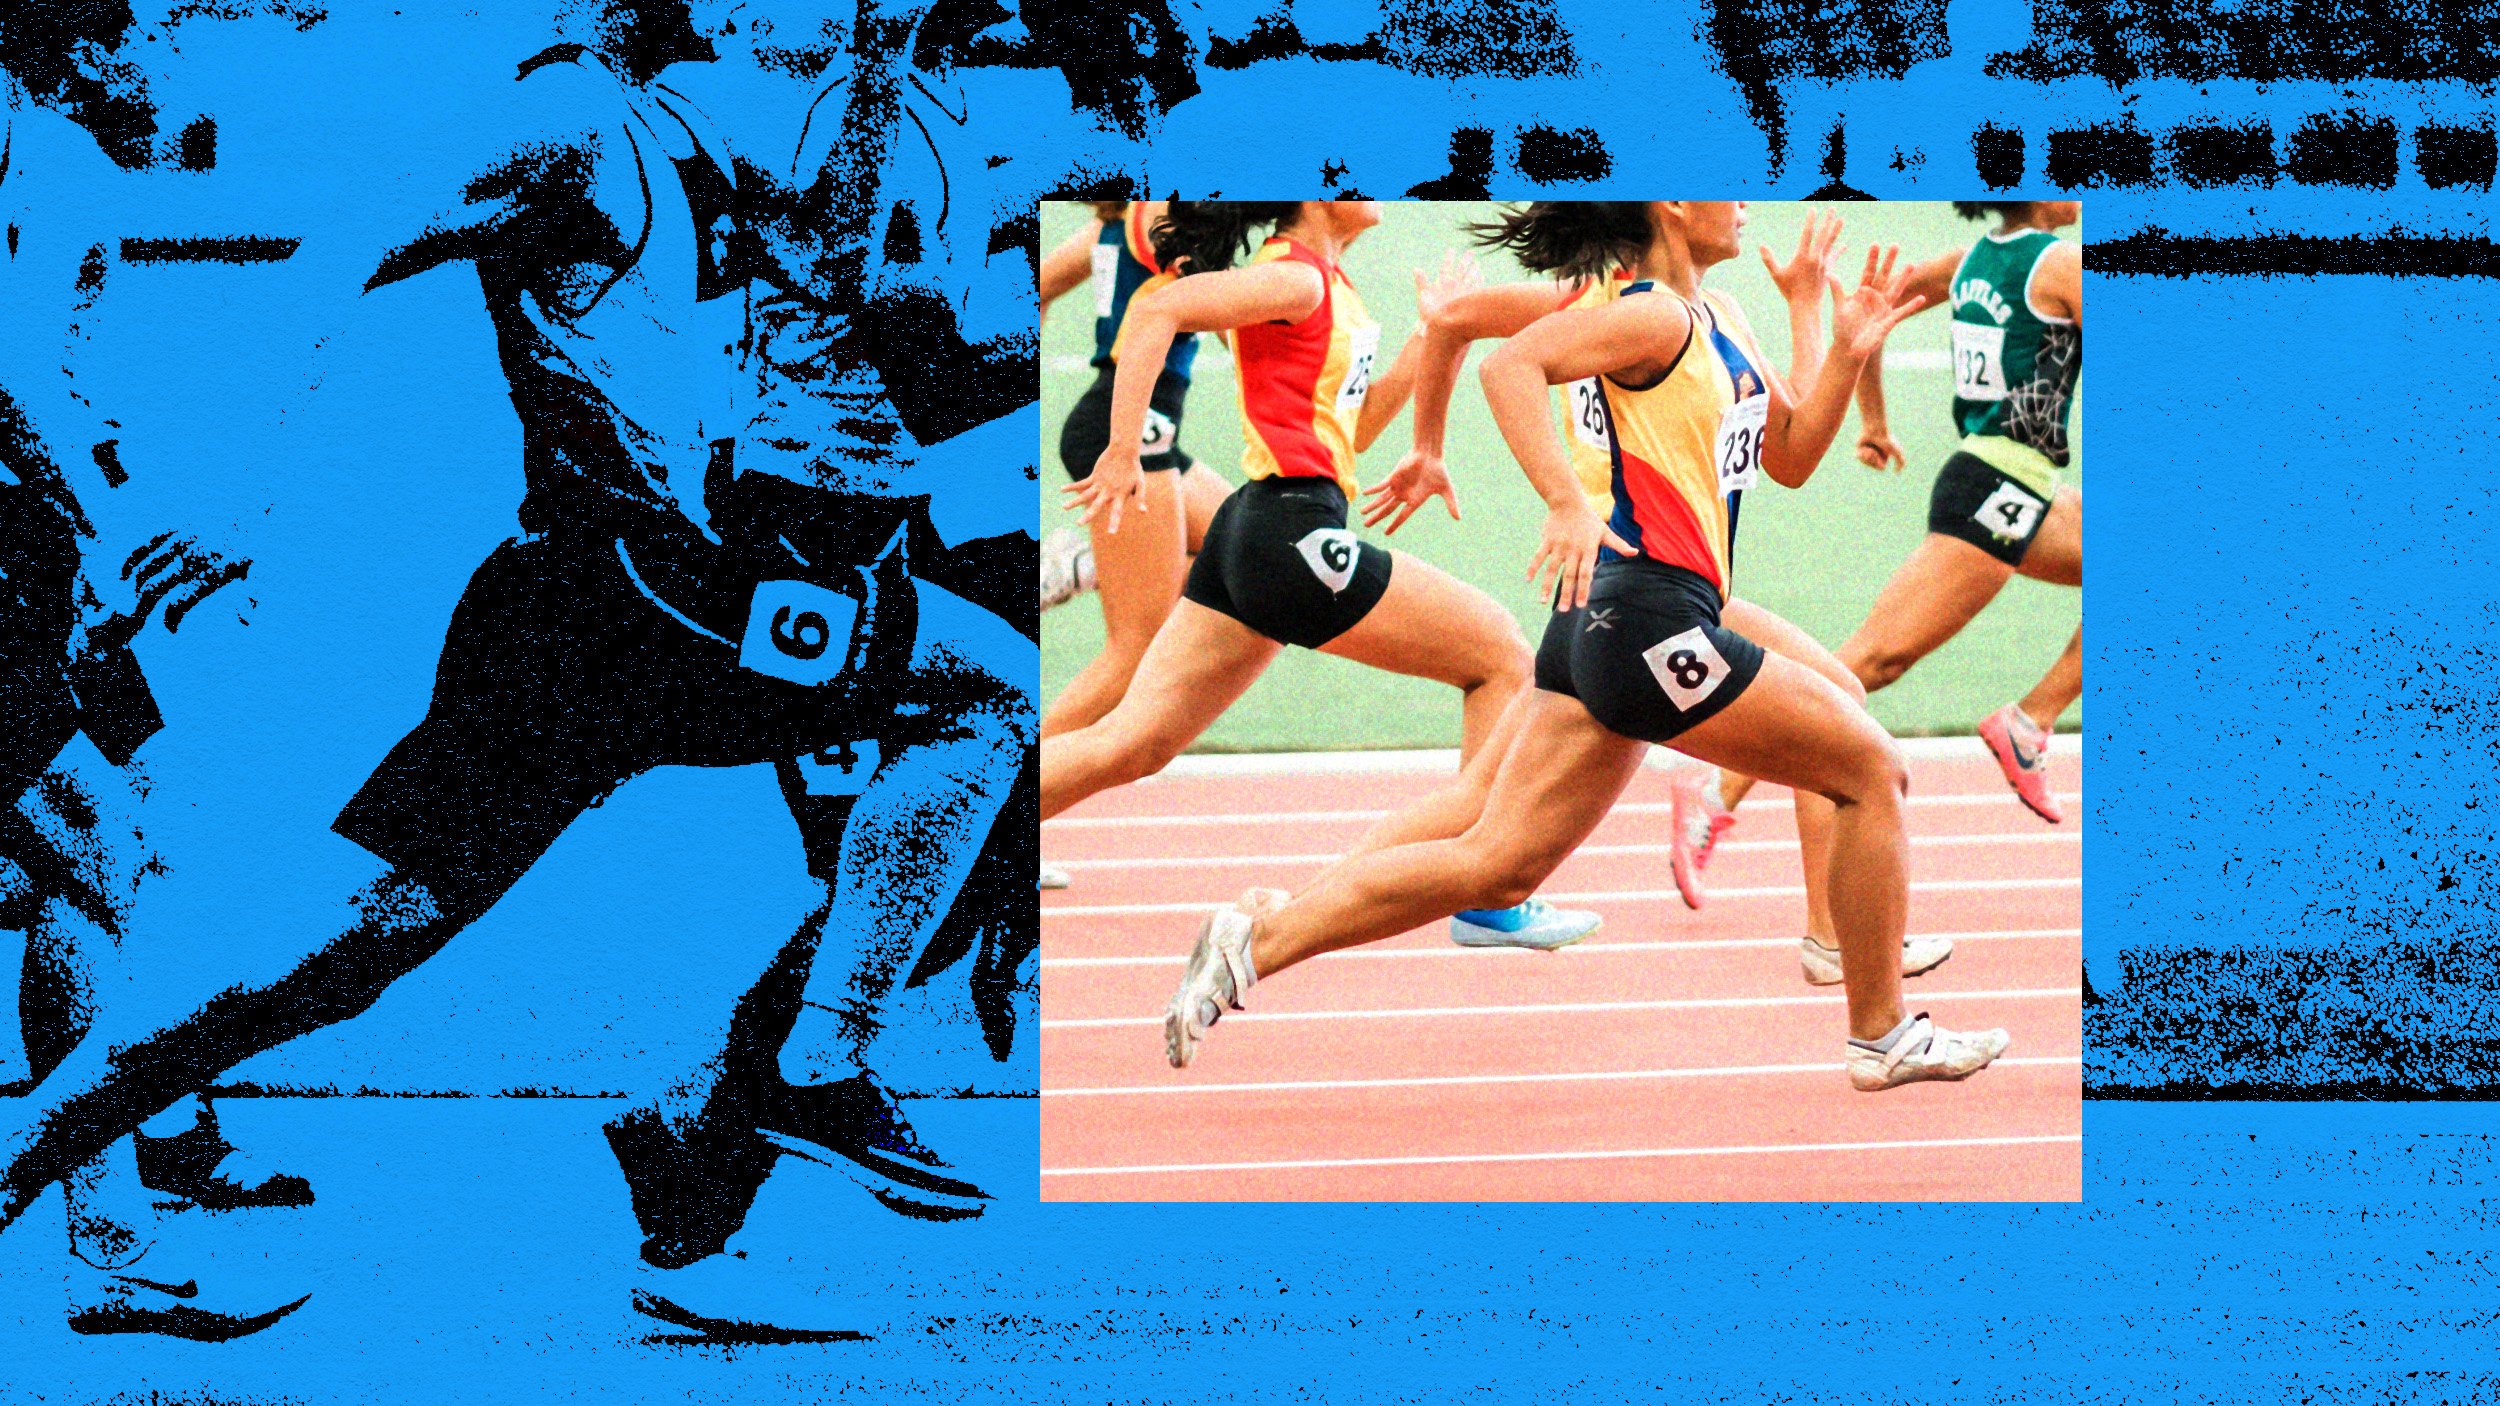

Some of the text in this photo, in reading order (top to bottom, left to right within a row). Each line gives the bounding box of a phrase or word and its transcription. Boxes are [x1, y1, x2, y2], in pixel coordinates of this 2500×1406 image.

[1998, 502, 2024, 527] 4
[1321, 538, 1351, 573] 6
[1666, 649, 1709, 690] 8
